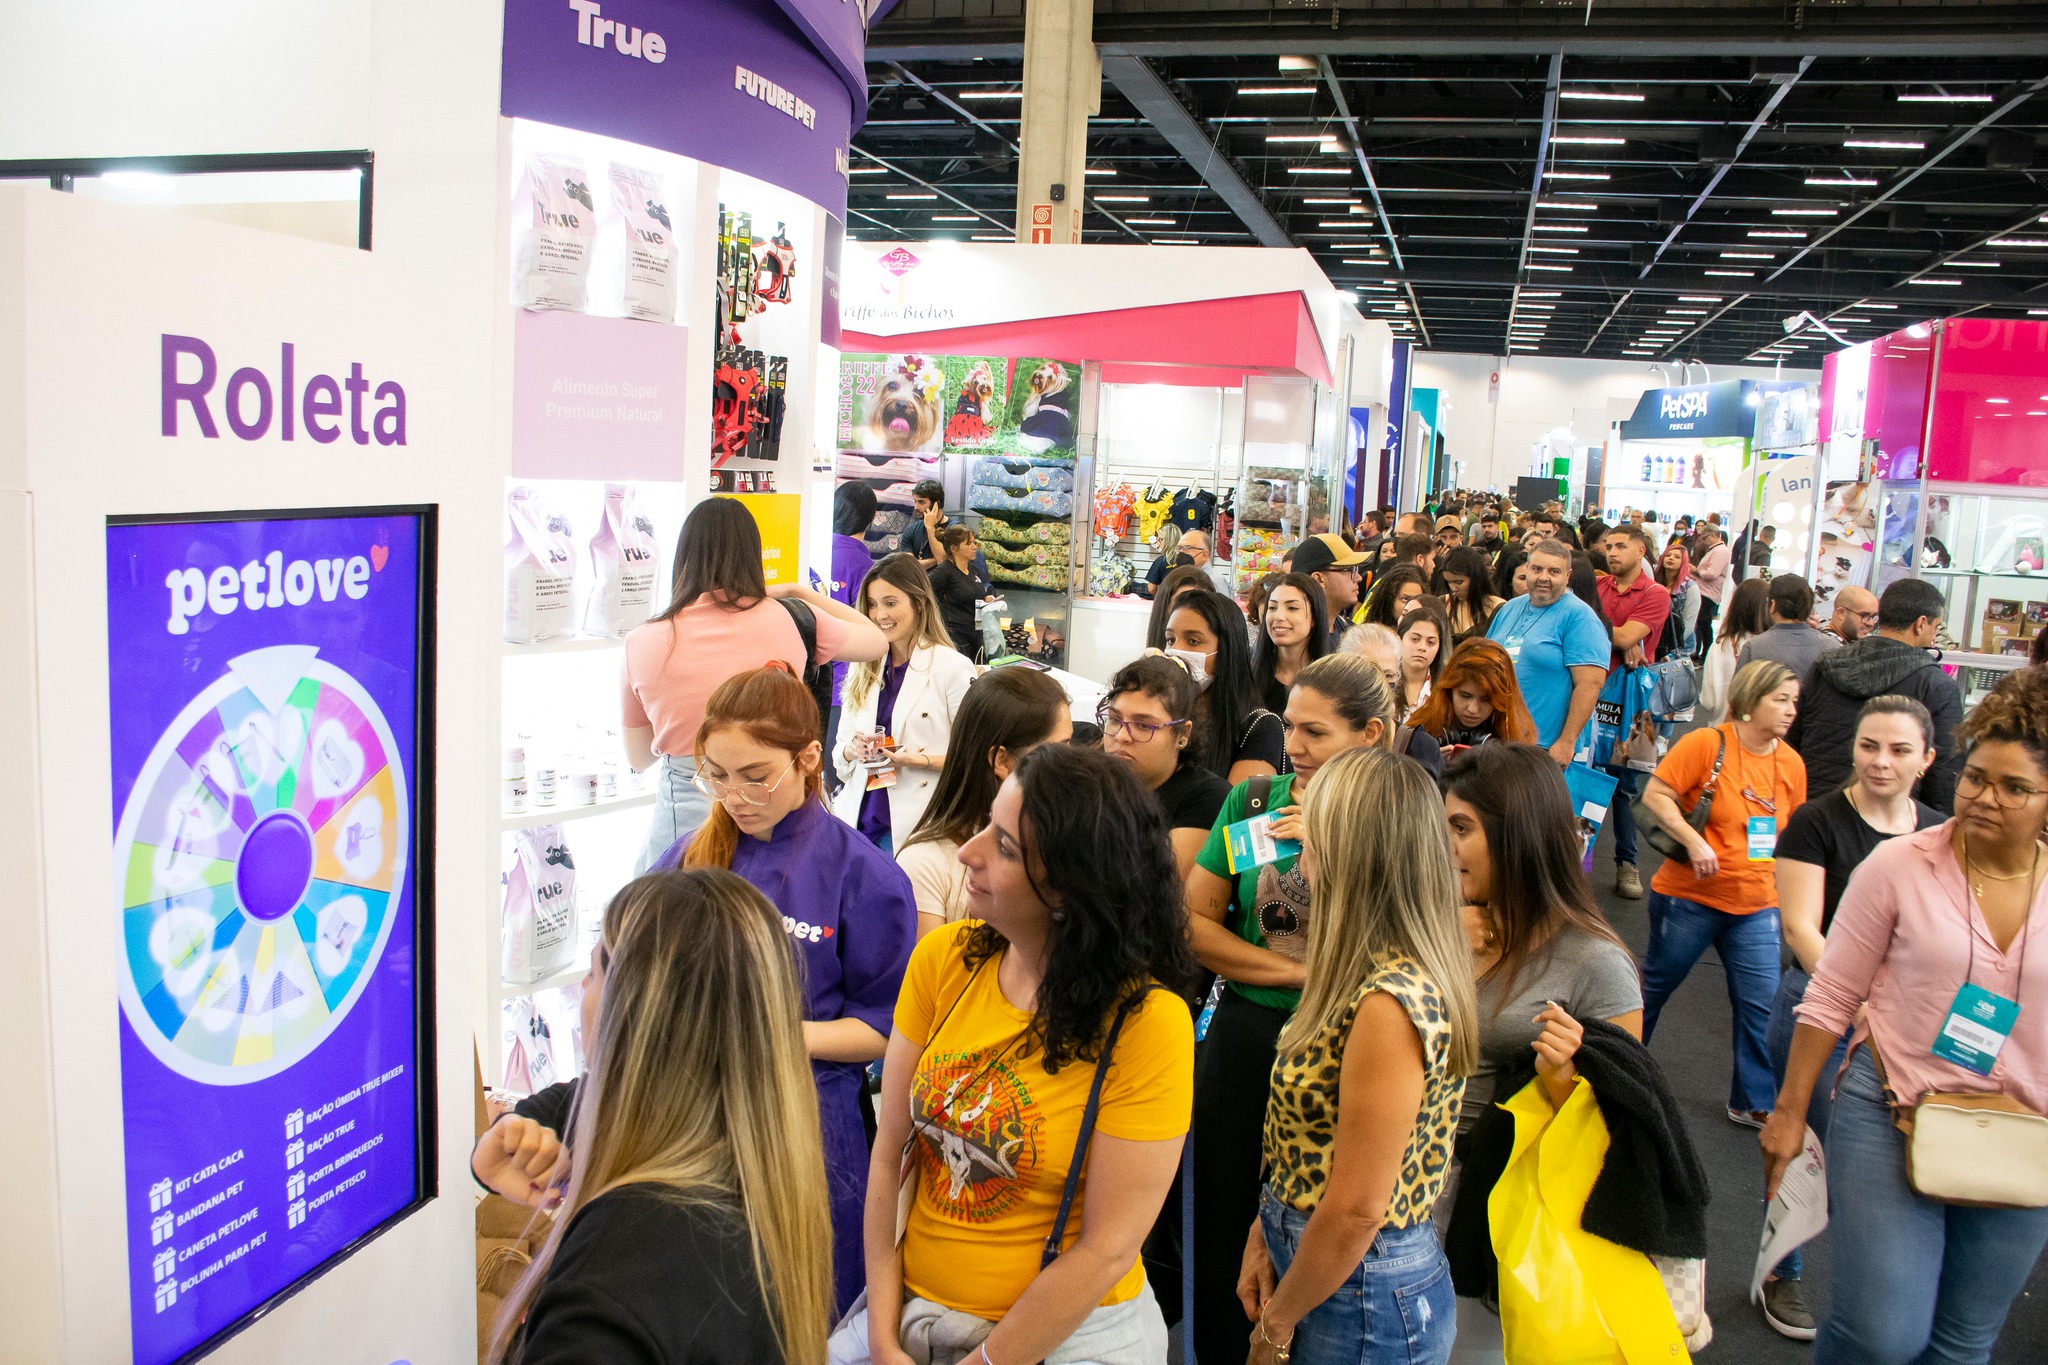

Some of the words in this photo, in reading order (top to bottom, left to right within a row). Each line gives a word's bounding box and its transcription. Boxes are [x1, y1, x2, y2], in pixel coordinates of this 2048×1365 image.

[569, 0, 667, 64] True
[734, 65, 795, 117] FUTURE
[794, 97, 816, 131] PET
[890, 249, 910, 262] GB
[879, 307, 898, 319] dos
[903, 303, 955, 321] Bichos
[161, 333, 408, 446] Roleta
[552, 378, 618, 397] Alimento
[622, 382, 659, 401] Super
[856, 376, 876, 396] 22
[1660, 391, 1709, 420] PetSPA
[546, 402, 613, 420] Premium
[616, 405, 663, 422] Natural
[839, 376, 853, 442] BICHOS
[951, 435, 977, 445] Vestido
[1781, 476, 1811, 493] lan
[1187, 508, 1196, 520] 8
[165, 550, 370, 635] petlove
[1596, 702, 1621, 715] MULA
[1596, 712, 1619, 725] URAL
[306, 1103, 334, 1125] RAÇÃO
[335, 1087, 361, 1109] ÚMIDA
[361, 1077, 381, 1094] TRUE
[381, 1064, 404, 1083] MIXER
[933, 1051, 981, 1065] LUCKY
[988, 1058, 1033, 1107] ENOUGH
[911, 1073, 1027, 1154] TEXAS
[307, 1131, 335, 1155] RAÇÃO
[335, 1119, 356, 1138] TRUE
[308, 1163, 334, 1186] PORTA
[335, 1133, 384, 1170] BRINQUEDOS
[175, 1177, 191, 1195] KIT
[193, 1163, 218, 1185] CATA
[218, 1149, 244, 1170] CACA
[308, 1189, 335, 1213] PORTA
[335, 1169, 367, 1196] PETISCO
[177, 1192, 226, 1227] BANDANA
[226, 1180, 245, 1199] PET
[178, 1233, 217, 1262] CANETA
[218, 1207, 259, 1240] PETLOVE
[180, 1259, 224, 1294] BOLINHA
[225, 1243, 250, 1266] PARA
[250, 1231, 267, 1250] PET
